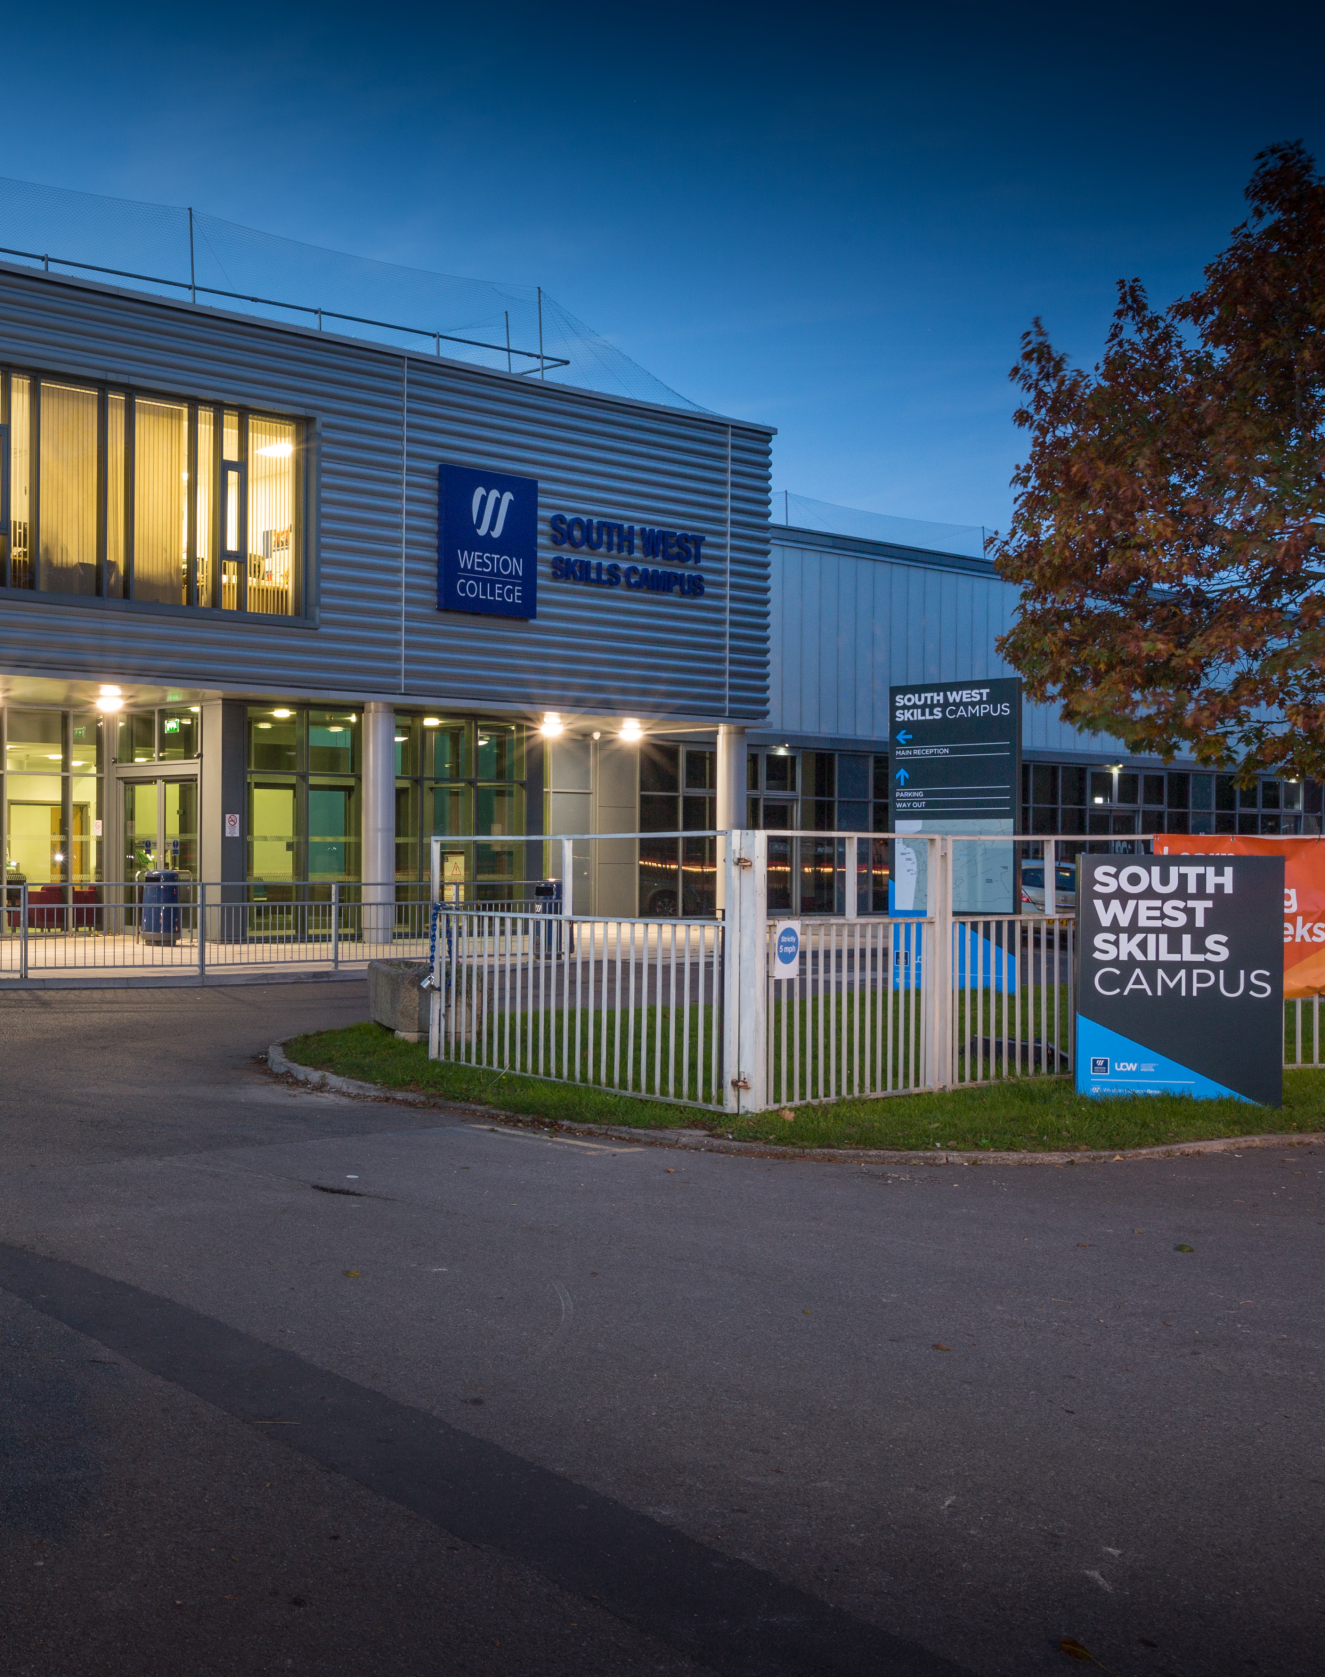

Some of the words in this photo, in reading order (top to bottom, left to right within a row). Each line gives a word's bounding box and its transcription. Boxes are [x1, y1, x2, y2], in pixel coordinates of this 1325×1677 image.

[550, 513, 635, 556] SOUTH
[640, 527, 706, 564] WEST
[457, 549, 523, 576] WESTON
[551, 555, 621, 587] SKILLS
[625, 565, 706, 597] CAMPUS
[456, 579, 522, 603] COLLEGE
[896, 692, 943, 706] SOUTH
[947, 689, 990, 703] WEST
[896, 707, 942, 721] SKILLS
[946, 703, 1010, 718] CAMPUS
[913, 748, 949, 756] RECEPTION
[1093, 865, 1233, 894] SOUTH
[1093, 899, 1213, 928] WEST
[784, 945, 795, 954] mph
[1092, 933, 1230, 962] SKILLS
[1094, 967, 1272, 998] CAMPUS
